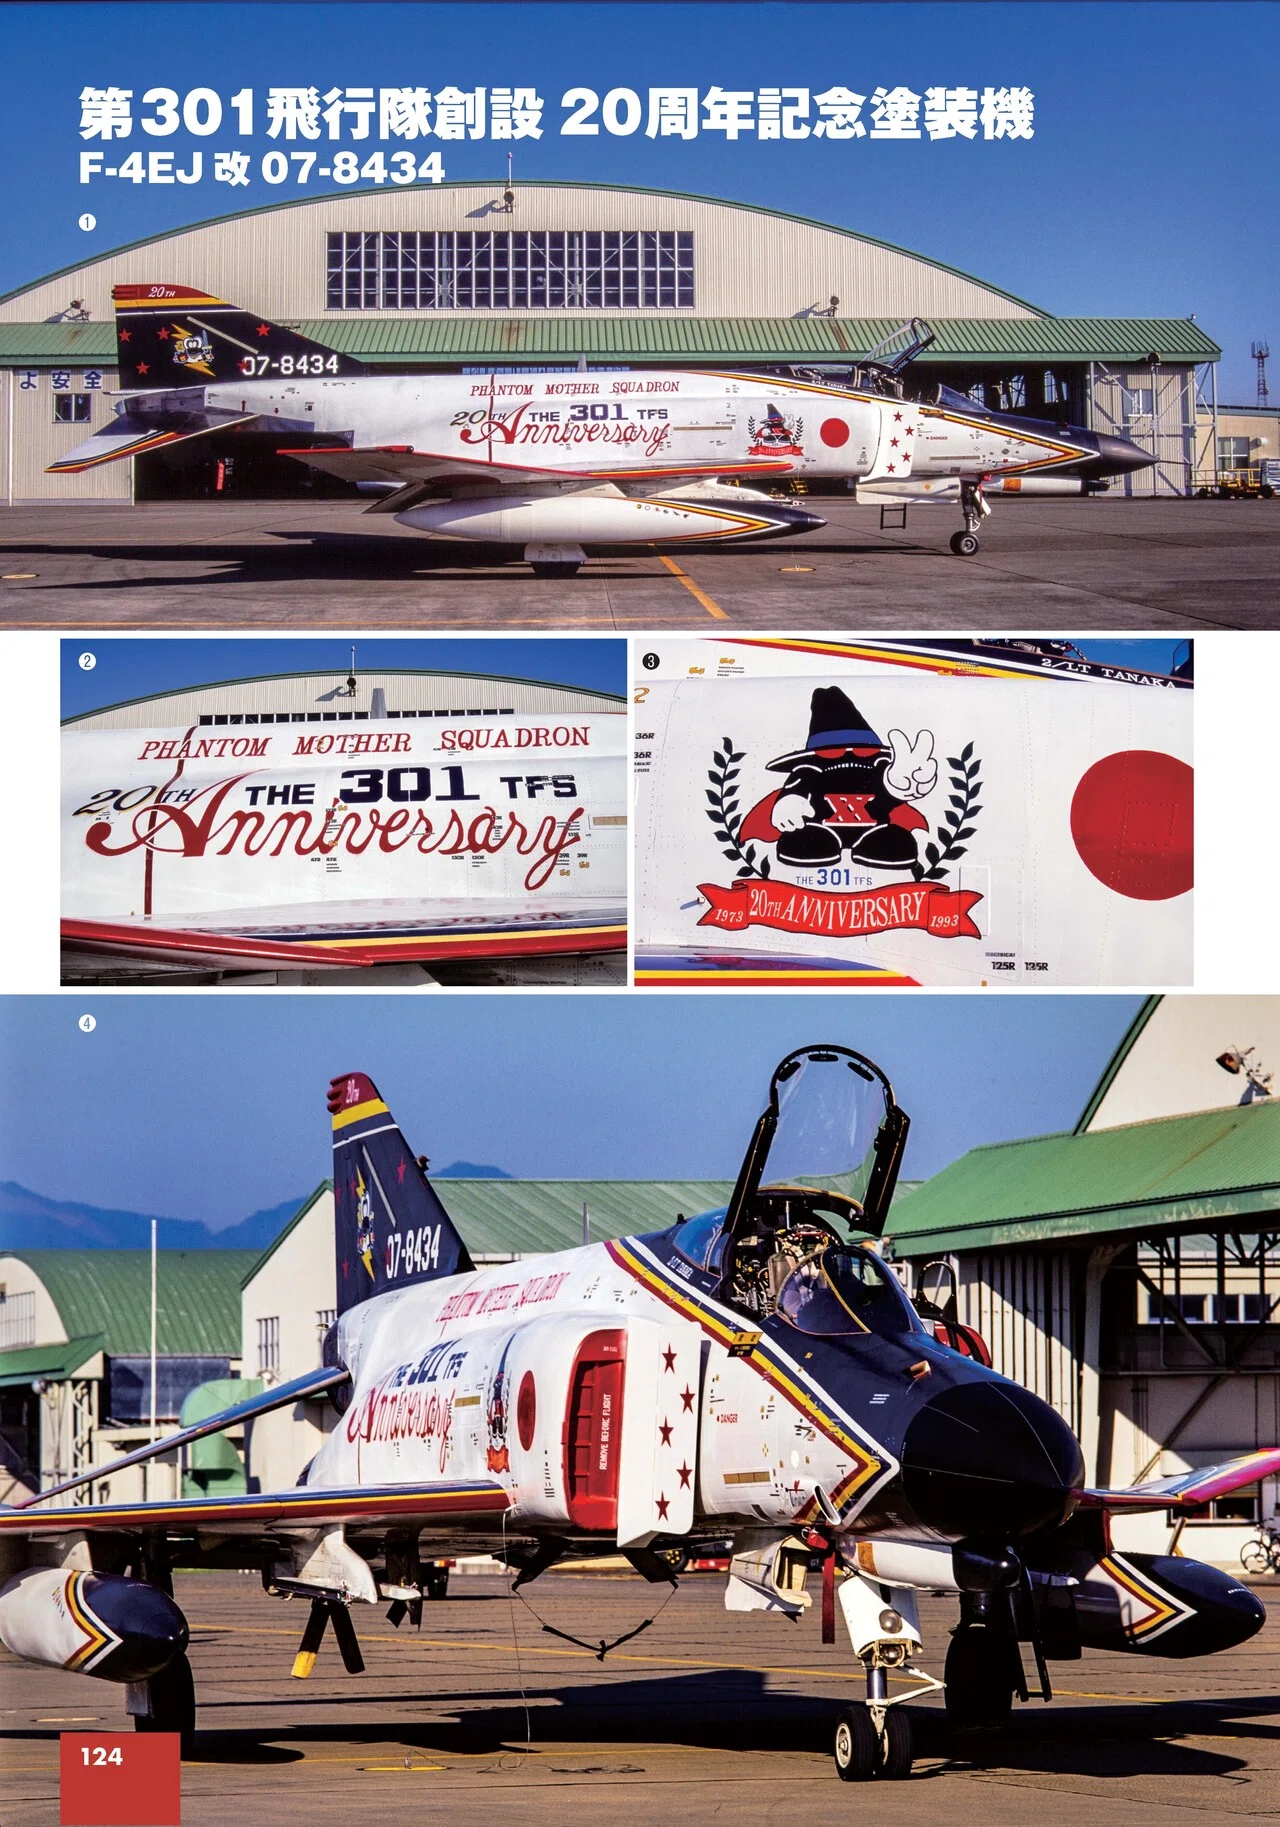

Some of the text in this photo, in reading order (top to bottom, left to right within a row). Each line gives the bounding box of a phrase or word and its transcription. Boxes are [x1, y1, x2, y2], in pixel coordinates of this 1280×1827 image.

[242, 354, 339, 376] 07-8434
[470, 381, 680, 396] PHANTOM MOTHER SQUADRON
[529, 404, 668, 422] THE 301 TFS
[460, 401, 671, 457] Anniversary
[1041, 658, 1176, 688] 2/LT TANAKA
[137, 737, 272, 760] PHANTOM
[292, 732, 412, 756] MOTHER
[441, 727, 591, 751] SQUADRON
[245, 783, 316, 806] THE
[339, 766, 480, 803] 301
[499, 774, 578, 799] TFS
[85, 769, 585, 891] Anniversary
[796, 869, 873, 886] THE 301 TFS
[715, 908, 744, 923] 1973
[781, 891, 926, 930] ANNIVERSARY
[930, 914, 960, 929] 1993
[991, 961, 1049, 971] 125R 125R
[386, 1224, 442, 1279] 07-8434
[720, 1413, 739, 1424] DANGER
[599, 1393, 612, 1471] REMOVE BEFORE FLIGHT
